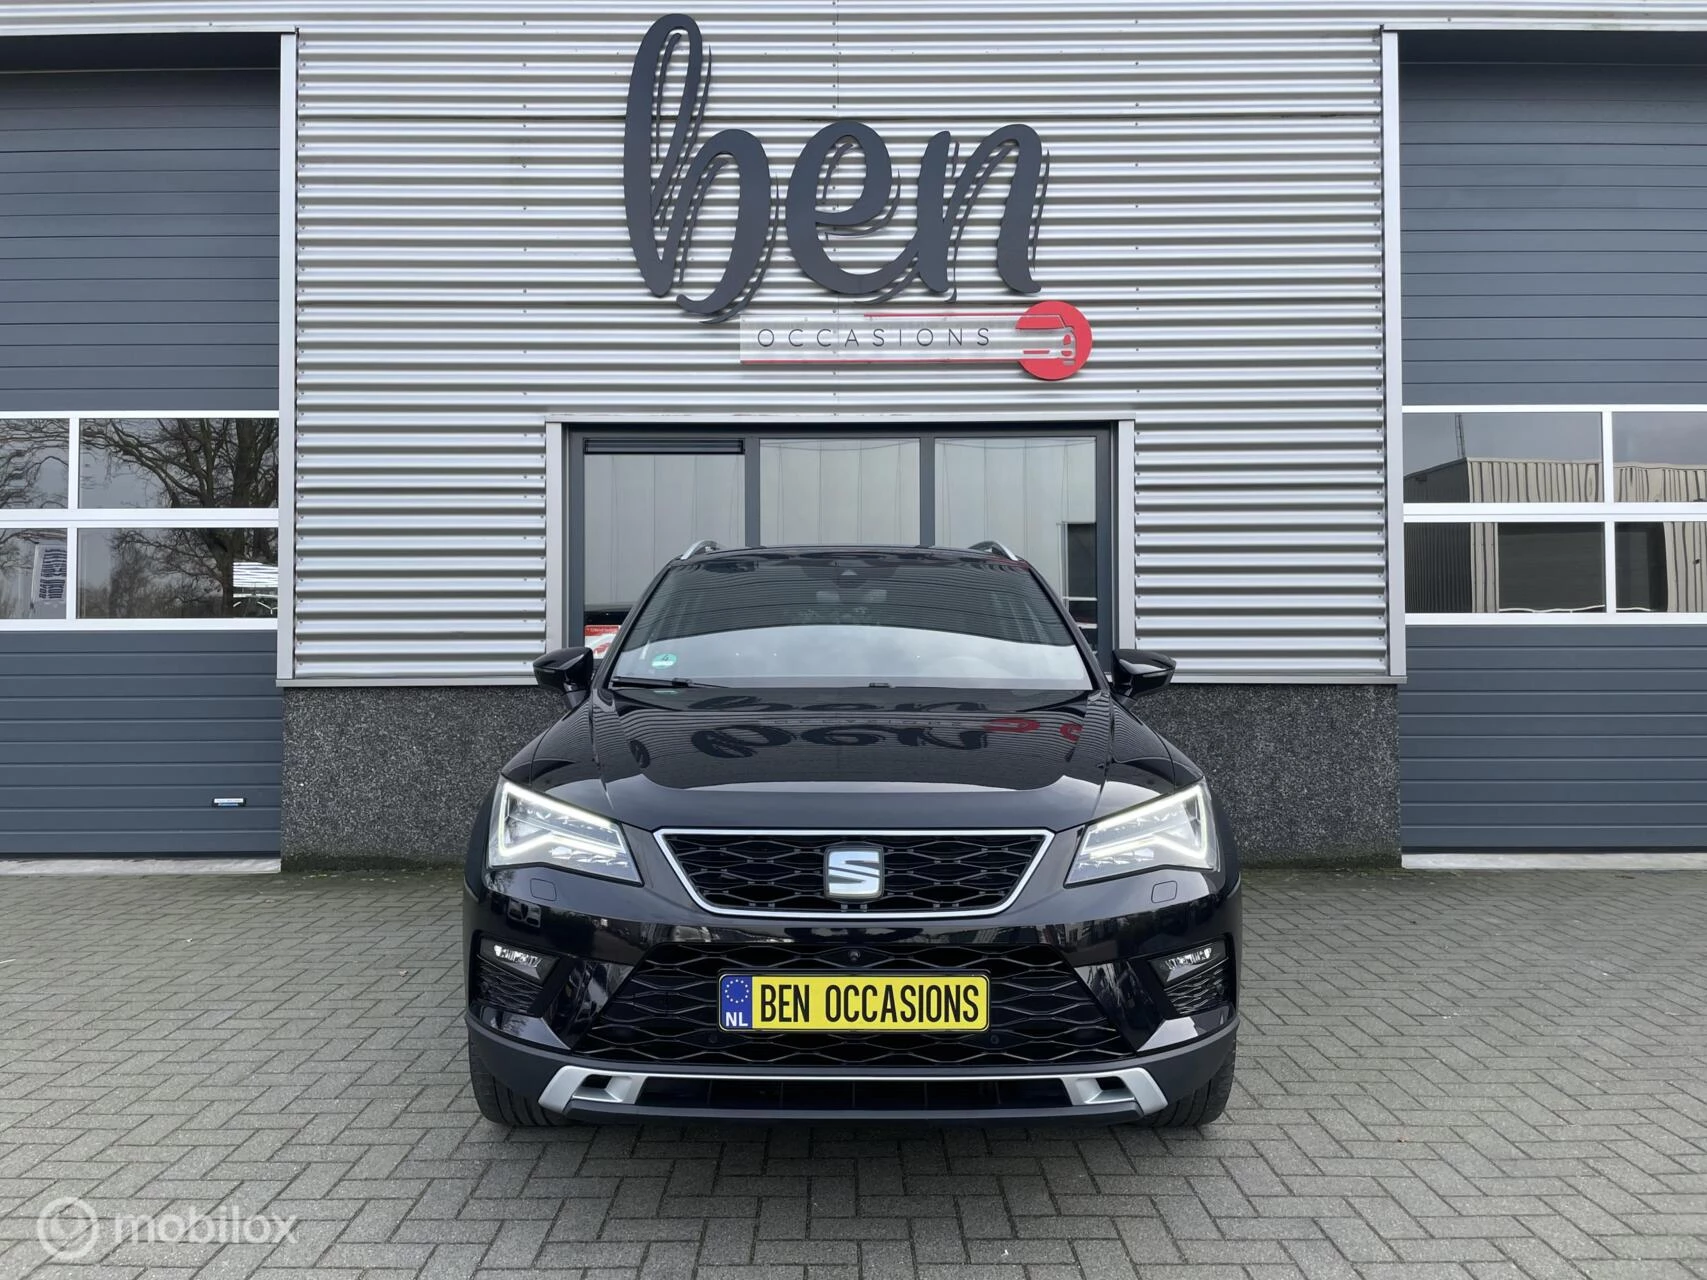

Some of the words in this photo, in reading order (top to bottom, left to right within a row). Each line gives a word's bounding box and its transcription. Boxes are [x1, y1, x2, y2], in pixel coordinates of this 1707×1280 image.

[624, 13, 1043, 316] ben
[757, 327, 991, 349] OCCASIONS
[760, 984, 810, 1023] BEN
[825, 984, 979, 1023] OCCASIONS
[725, 1011, 748, 1027] NL
